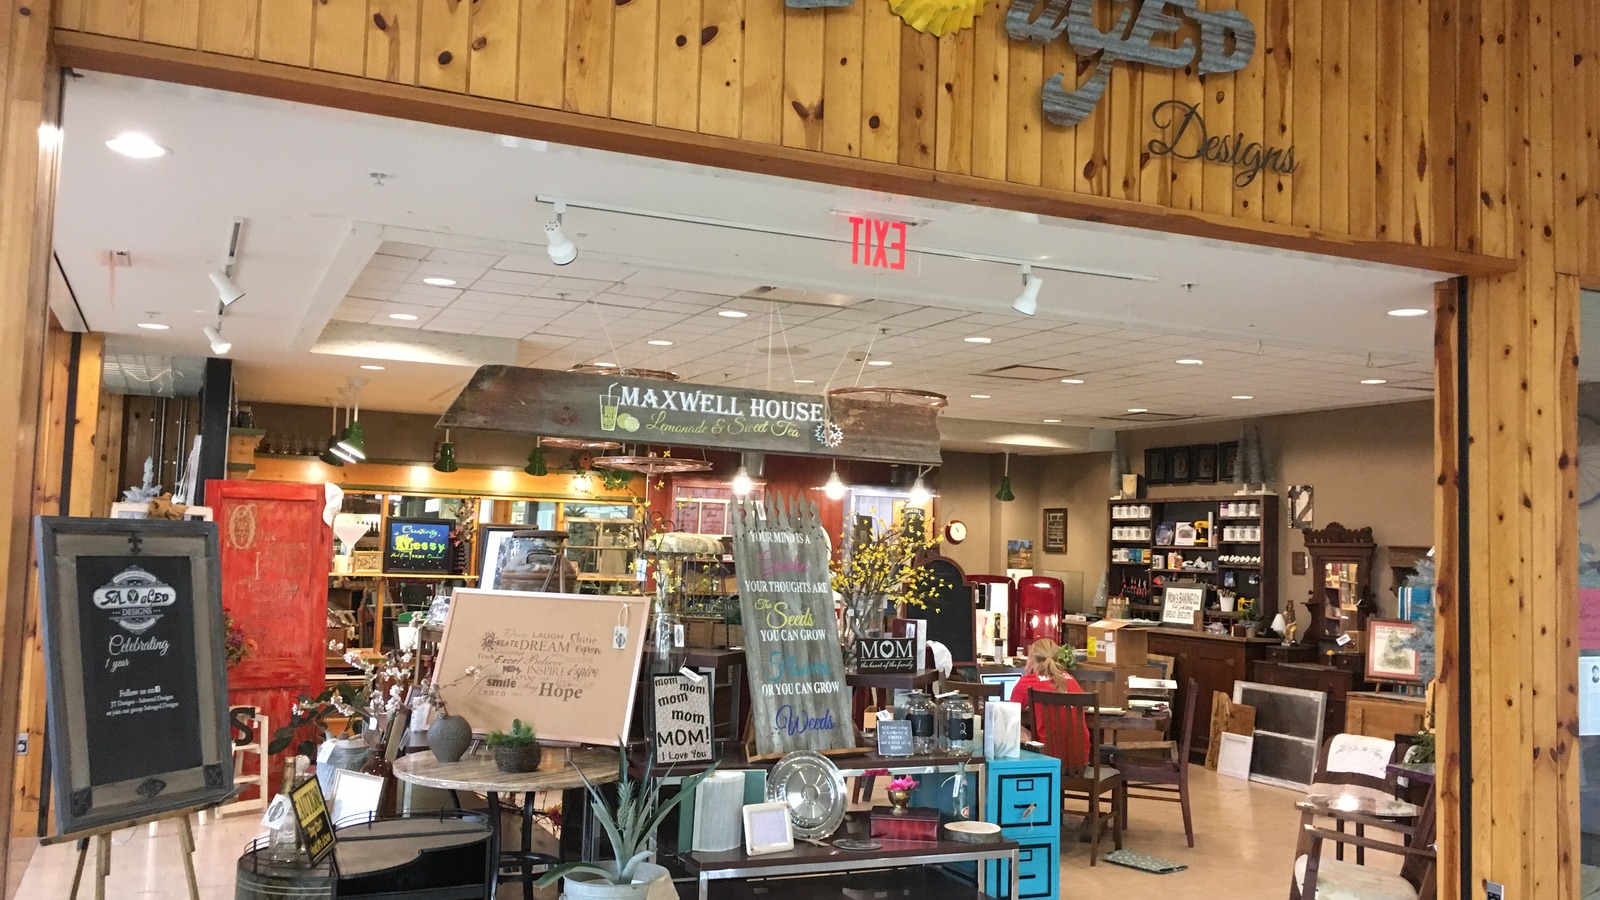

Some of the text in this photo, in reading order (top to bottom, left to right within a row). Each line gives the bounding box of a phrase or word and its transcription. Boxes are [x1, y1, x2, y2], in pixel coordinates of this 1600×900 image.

[1148, 100, 1299, 188] Designs
[620, 386, 824, 423] MAXWELL HOUSE
[645, 411, 801, 438] Lemonade & Sweet Tea
[749, 530, 812, 544] YOUR MIND IS A
[745, 580, 829, 594] YOUR THOUGHTS ARE
[122, 607, 153, 616] DESIGNS
[766, 602, 816, 629] Seeds
[532, 632, 565, 640] LAUGH
[760, 628, 827, 641] YOU CAN GROW
[109, 634, 170, 656] Celebrating
[519, 639, 571, 654] DREAM
[860, 640, 914, 659] MOM
[110, 658, 130, 673] year
[493, 655, 525, 664] Excel
[896, 660, 913, 670] family
[526, 665, 568, 677] INSPIRE
[486, 678, 517, 689] smile
[655, 676, 678, 687] mom
[680, 682, 706, 695] mom
[761, 681, 840, 696] OR YOU CAN GROW
[538, 681, 584, 702] Hope
[657, 692, 688, 707] mom
[671, 709, 705, 724] mom
[776, 705, 836, 736] Weeds
[959, 722, 967, 735] 2
[656, 726, 710, 748] MOM!
[661, 749, 707, 761] I Love You
